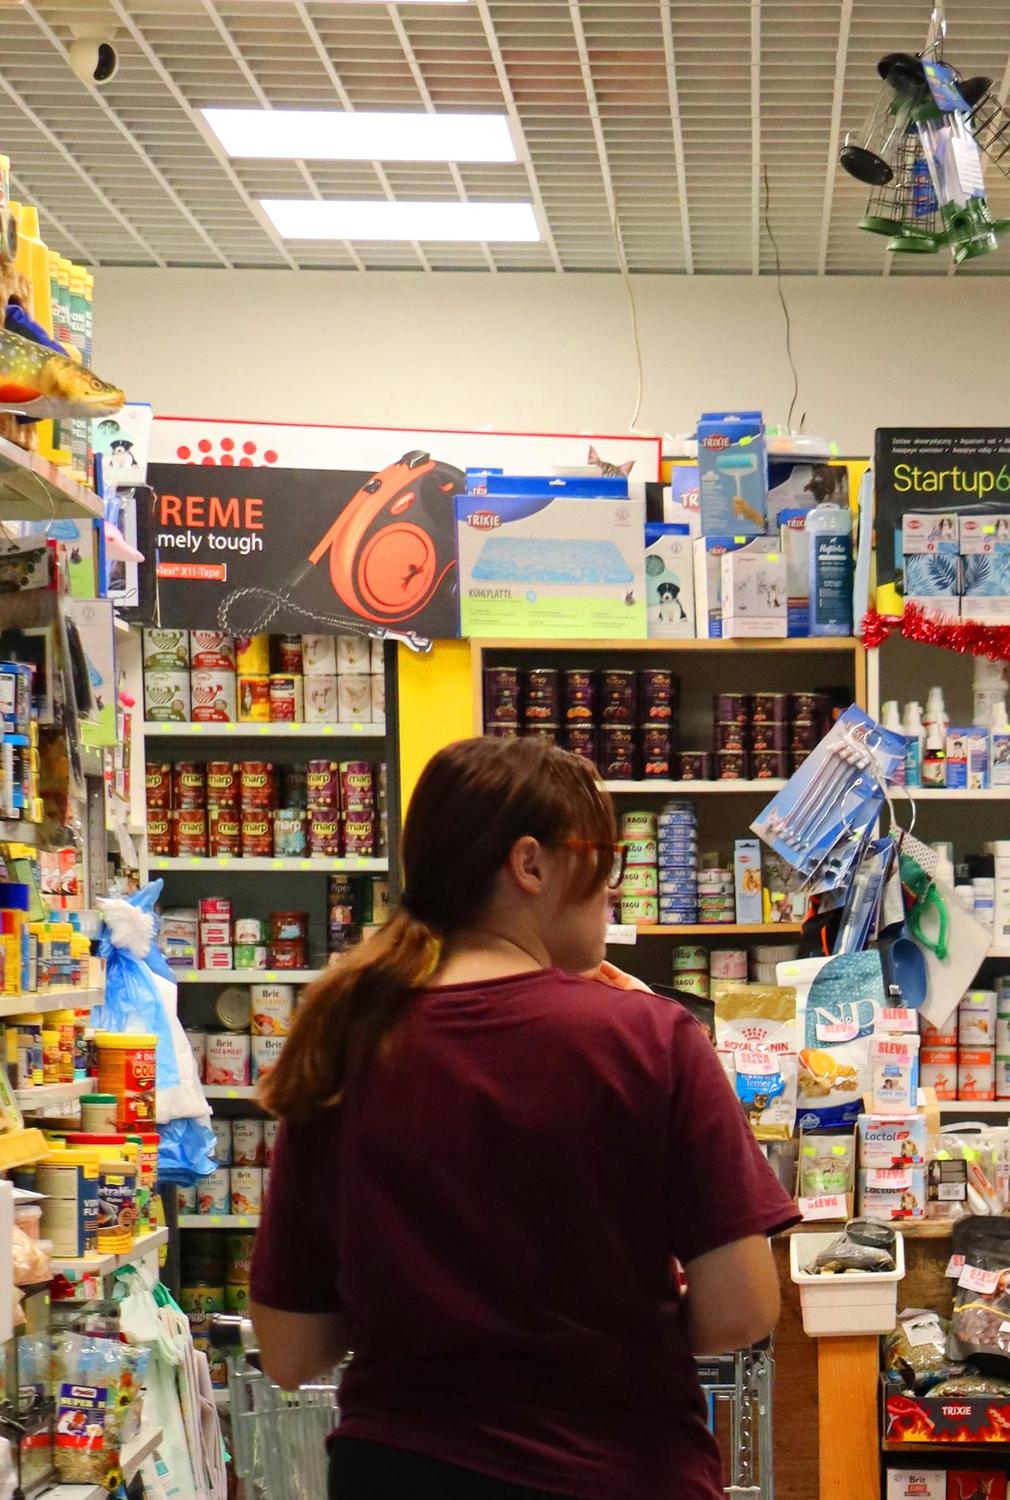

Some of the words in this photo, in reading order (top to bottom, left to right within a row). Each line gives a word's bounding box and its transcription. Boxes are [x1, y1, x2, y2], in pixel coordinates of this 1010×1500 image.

[160, 495, 264, 529] REME
[466, 514, 502, 528] TRIXIE
[157, 531, 203, 552] mely
[208, 533, 263, 554] tough
[242, 775, 267, 787] marp
[626, 816, 647, 825] RAGU
[243, 823, 268, 835] marp
[275, 821, 301, 833] marp
[313, 823, 337, 835] marp
[347, 823, 371, 835] marp
[262, 989, 279, 998] Brit
[882, 1008, 908, 1020] SLEVA
[216, 1039, 233, 1048] Brit
[265, 1040, 282, 1049] Brit
[724, 1041, 752, 1051] ROYAL
[879, 1041, 908, 1055] SLEVA
[865, 1131, 896, 1142] Lactol
[237, 1171, 251, 1180] Brit
[875, 1169, 906, 1180] SLEVA
[808, 1198, 838, 1209] SLEVA
[61, 1397, 93, 1408] SUPER
[942, 1406, 972, 1416] TRIXIE
[909, 1475, 926, 1484] Brit
